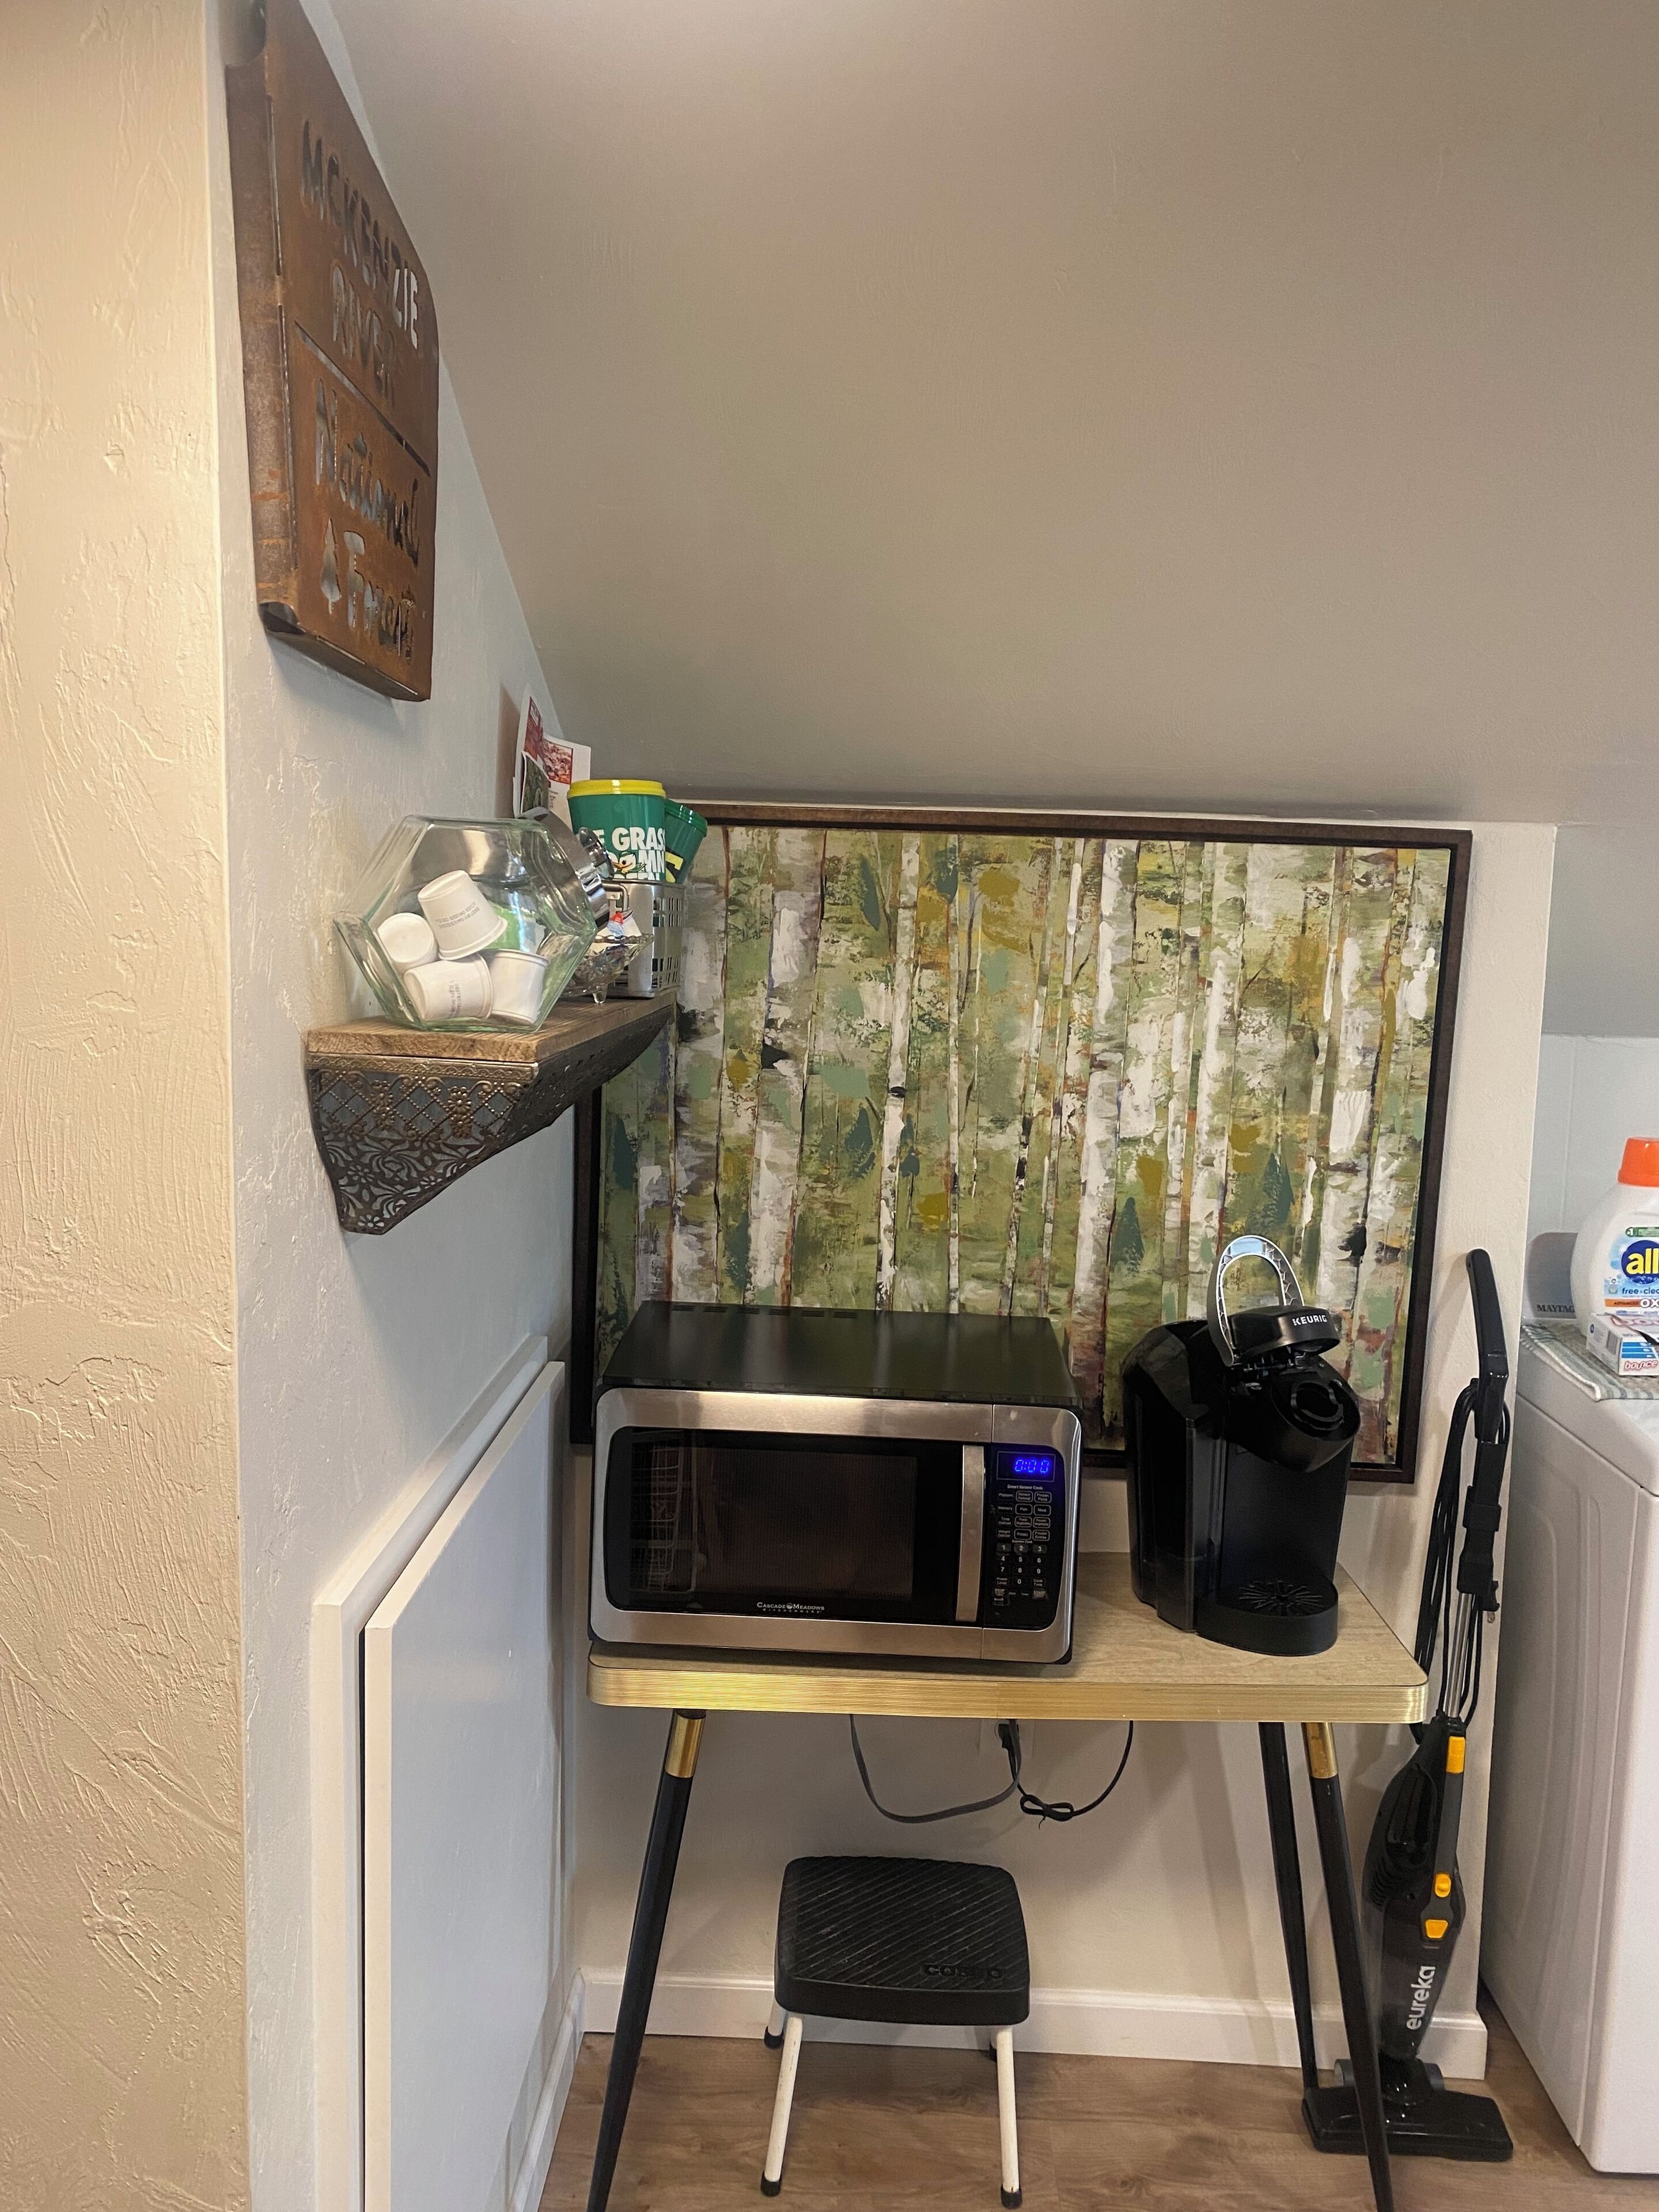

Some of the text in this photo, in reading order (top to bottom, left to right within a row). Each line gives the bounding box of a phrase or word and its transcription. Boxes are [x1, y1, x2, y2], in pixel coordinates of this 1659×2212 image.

[331, 264, 395, 407] RIVER
[1626, 1248, 1659, 1274] all
[1537, 1304, 1575, 1313] MAYTAG
[1292, 1315, 1327, 1326] KEURIG
[1624, 1359, 1658, 1370] bounce
[1014, 1459, 1049, 1474] 0:00
[1406, 1965, 1436, 2031] eureka
